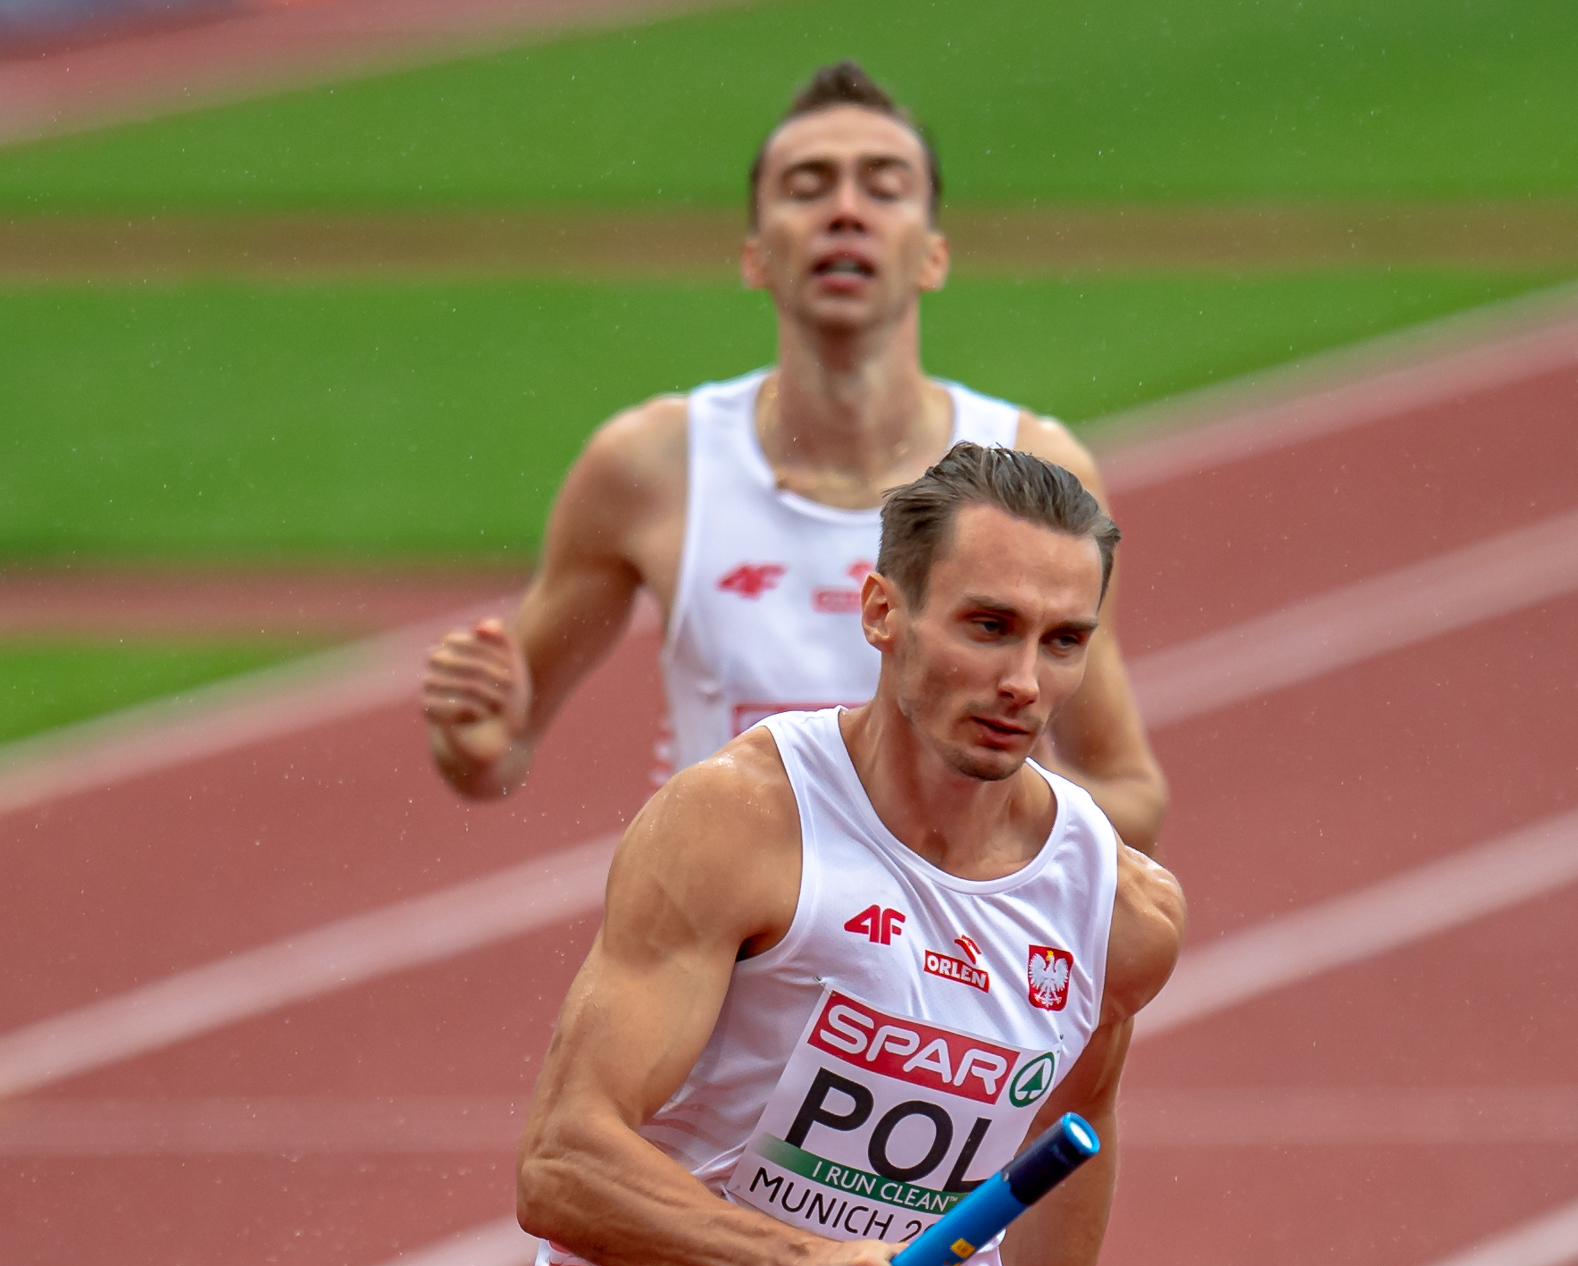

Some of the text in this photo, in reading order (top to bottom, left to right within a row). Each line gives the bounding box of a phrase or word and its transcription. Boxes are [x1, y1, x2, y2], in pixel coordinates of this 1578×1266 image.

[844, 904, 906, 945] 4F
[926, 954, 987, 989] ORLEN
[819, 1004, 1008, 1096] SPAR
[784, 1066, 992, 1193] POL
[749, 1166, 895, 1240] MUNICH
[812, 1161, 823, 1178] I
[825, 1165, 877, 1195] RUN
